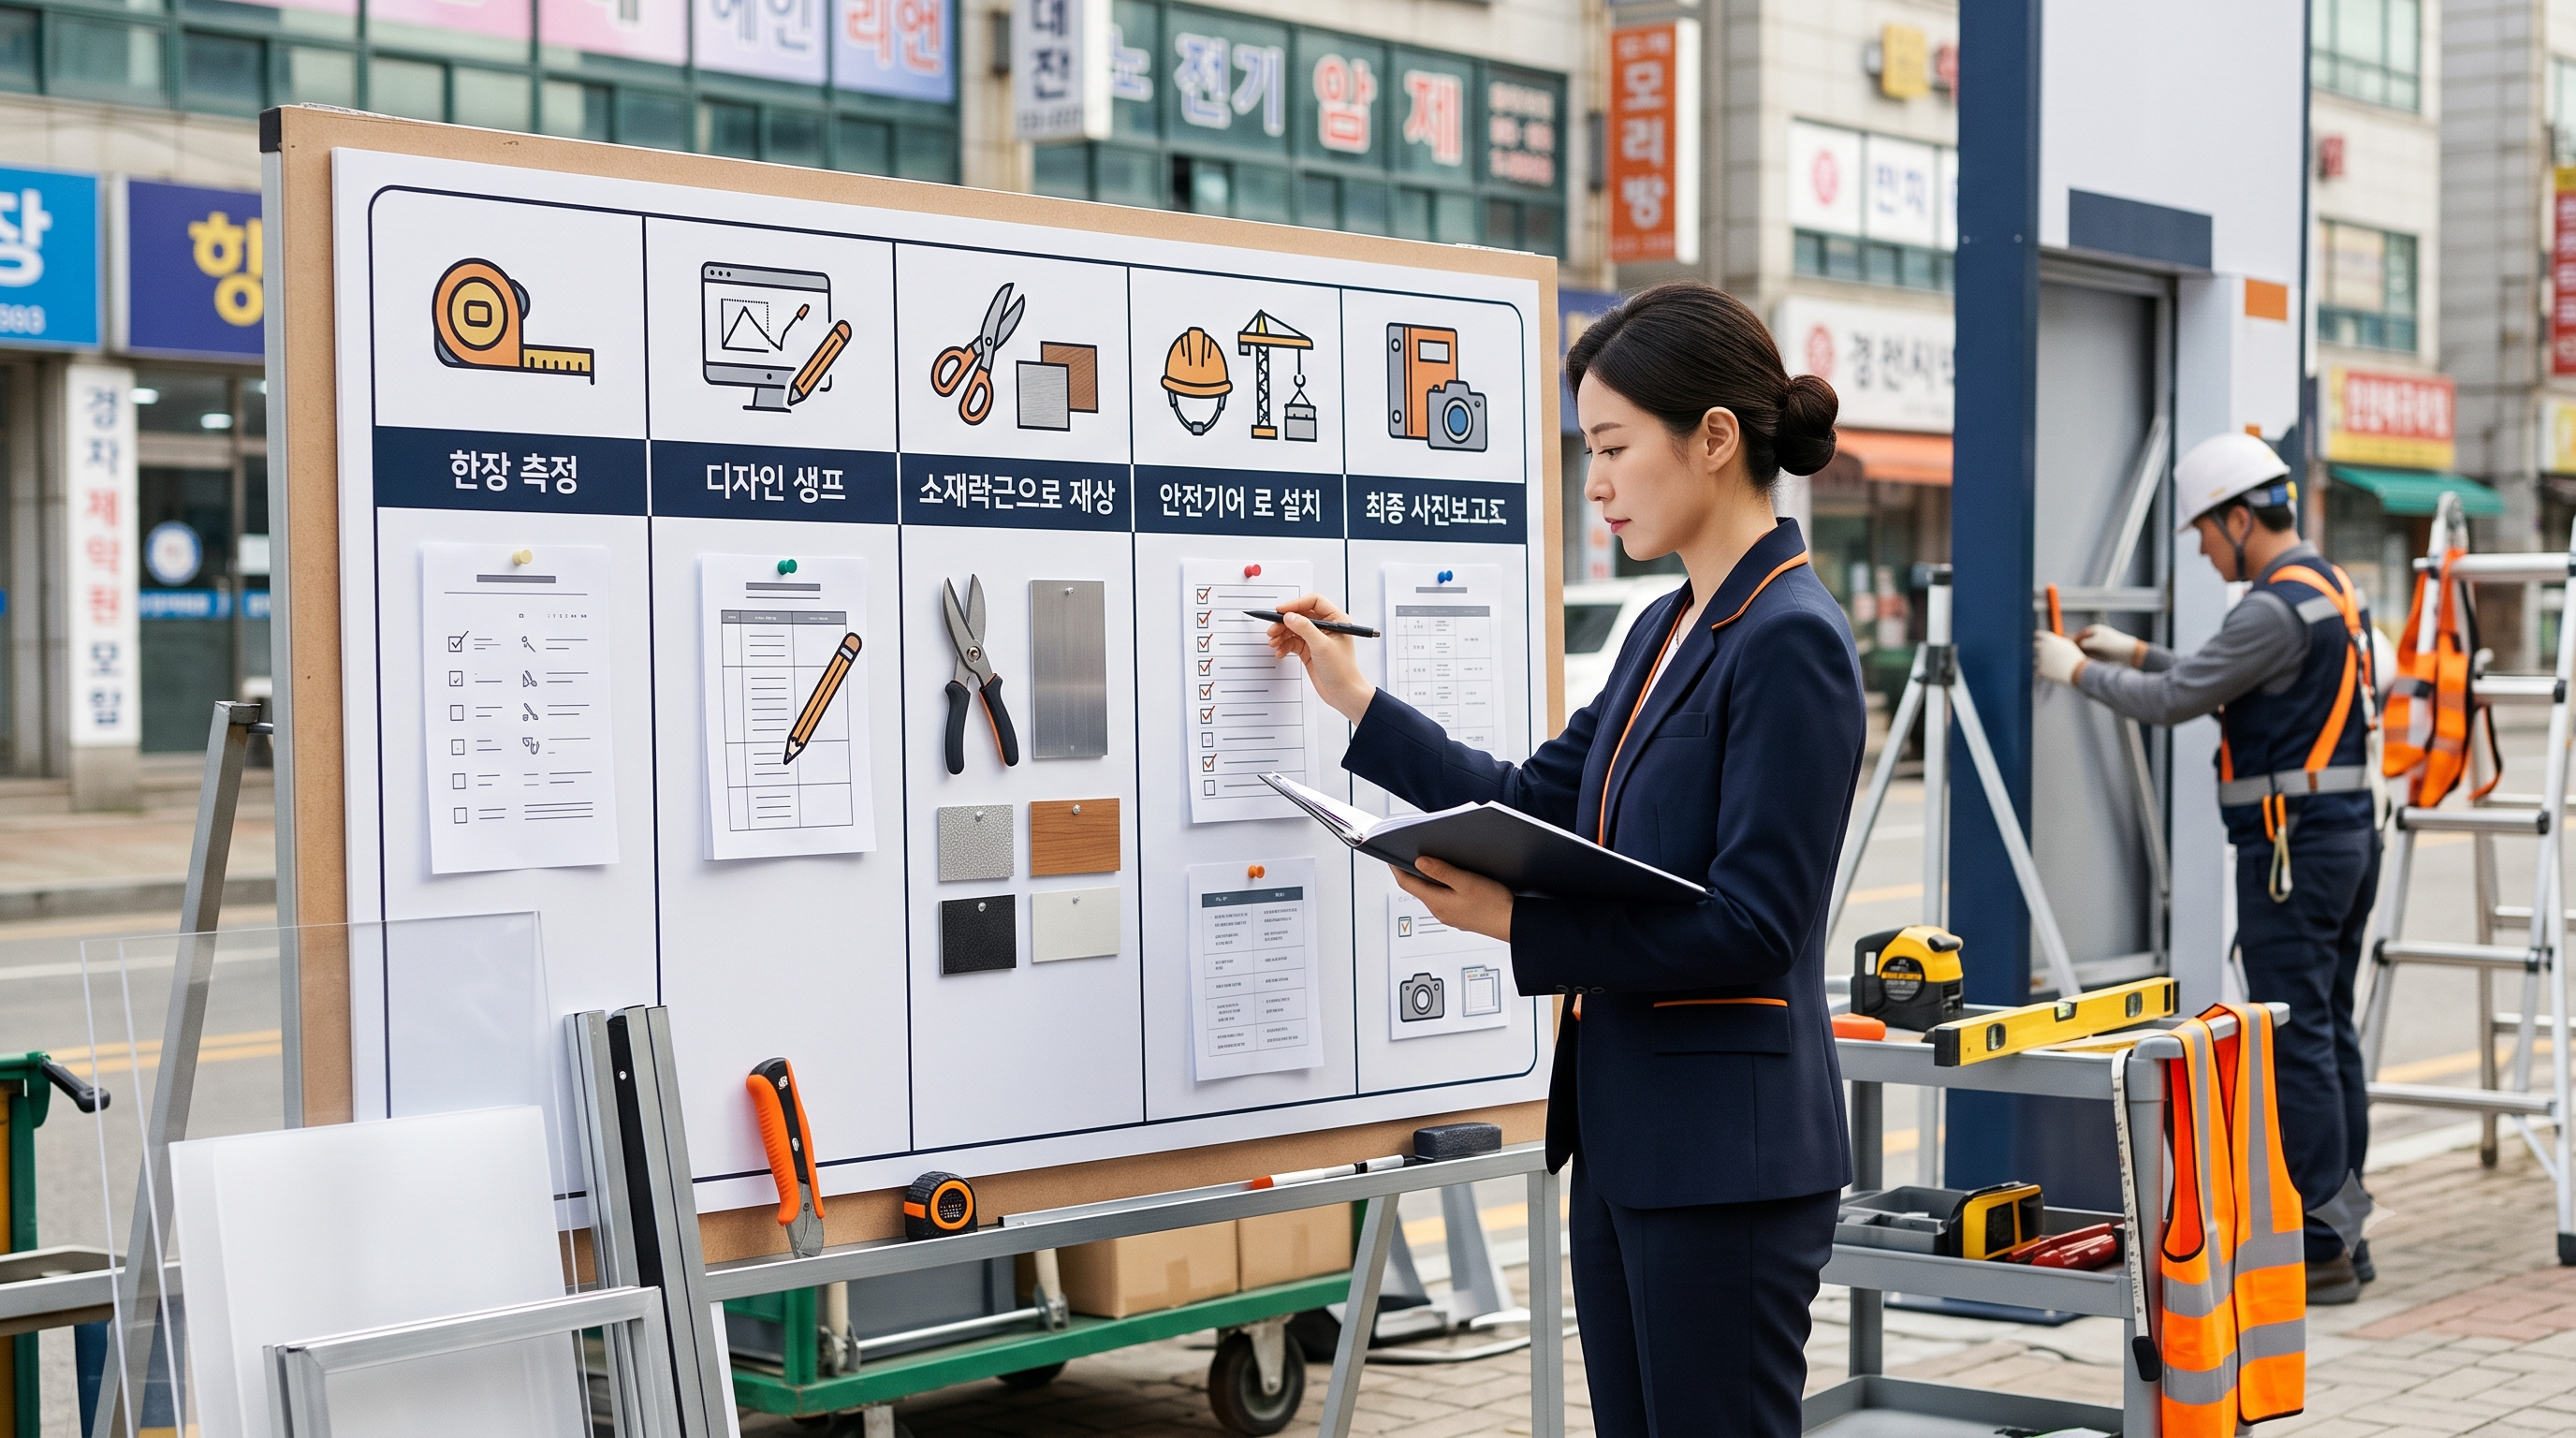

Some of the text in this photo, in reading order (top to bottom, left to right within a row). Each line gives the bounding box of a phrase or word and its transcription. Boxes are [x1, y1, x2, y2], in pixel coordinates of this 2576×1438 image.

[449, 449, 578, 494] 한장 측정
[707, 462, 846, 504] 디자인 생프
[919, 473, 1116, 515] 소재락근으로 재상
[1160, 482, 1321, 522] 안전기어 로 설치
[1366, 491, 1406, 525] 최종
